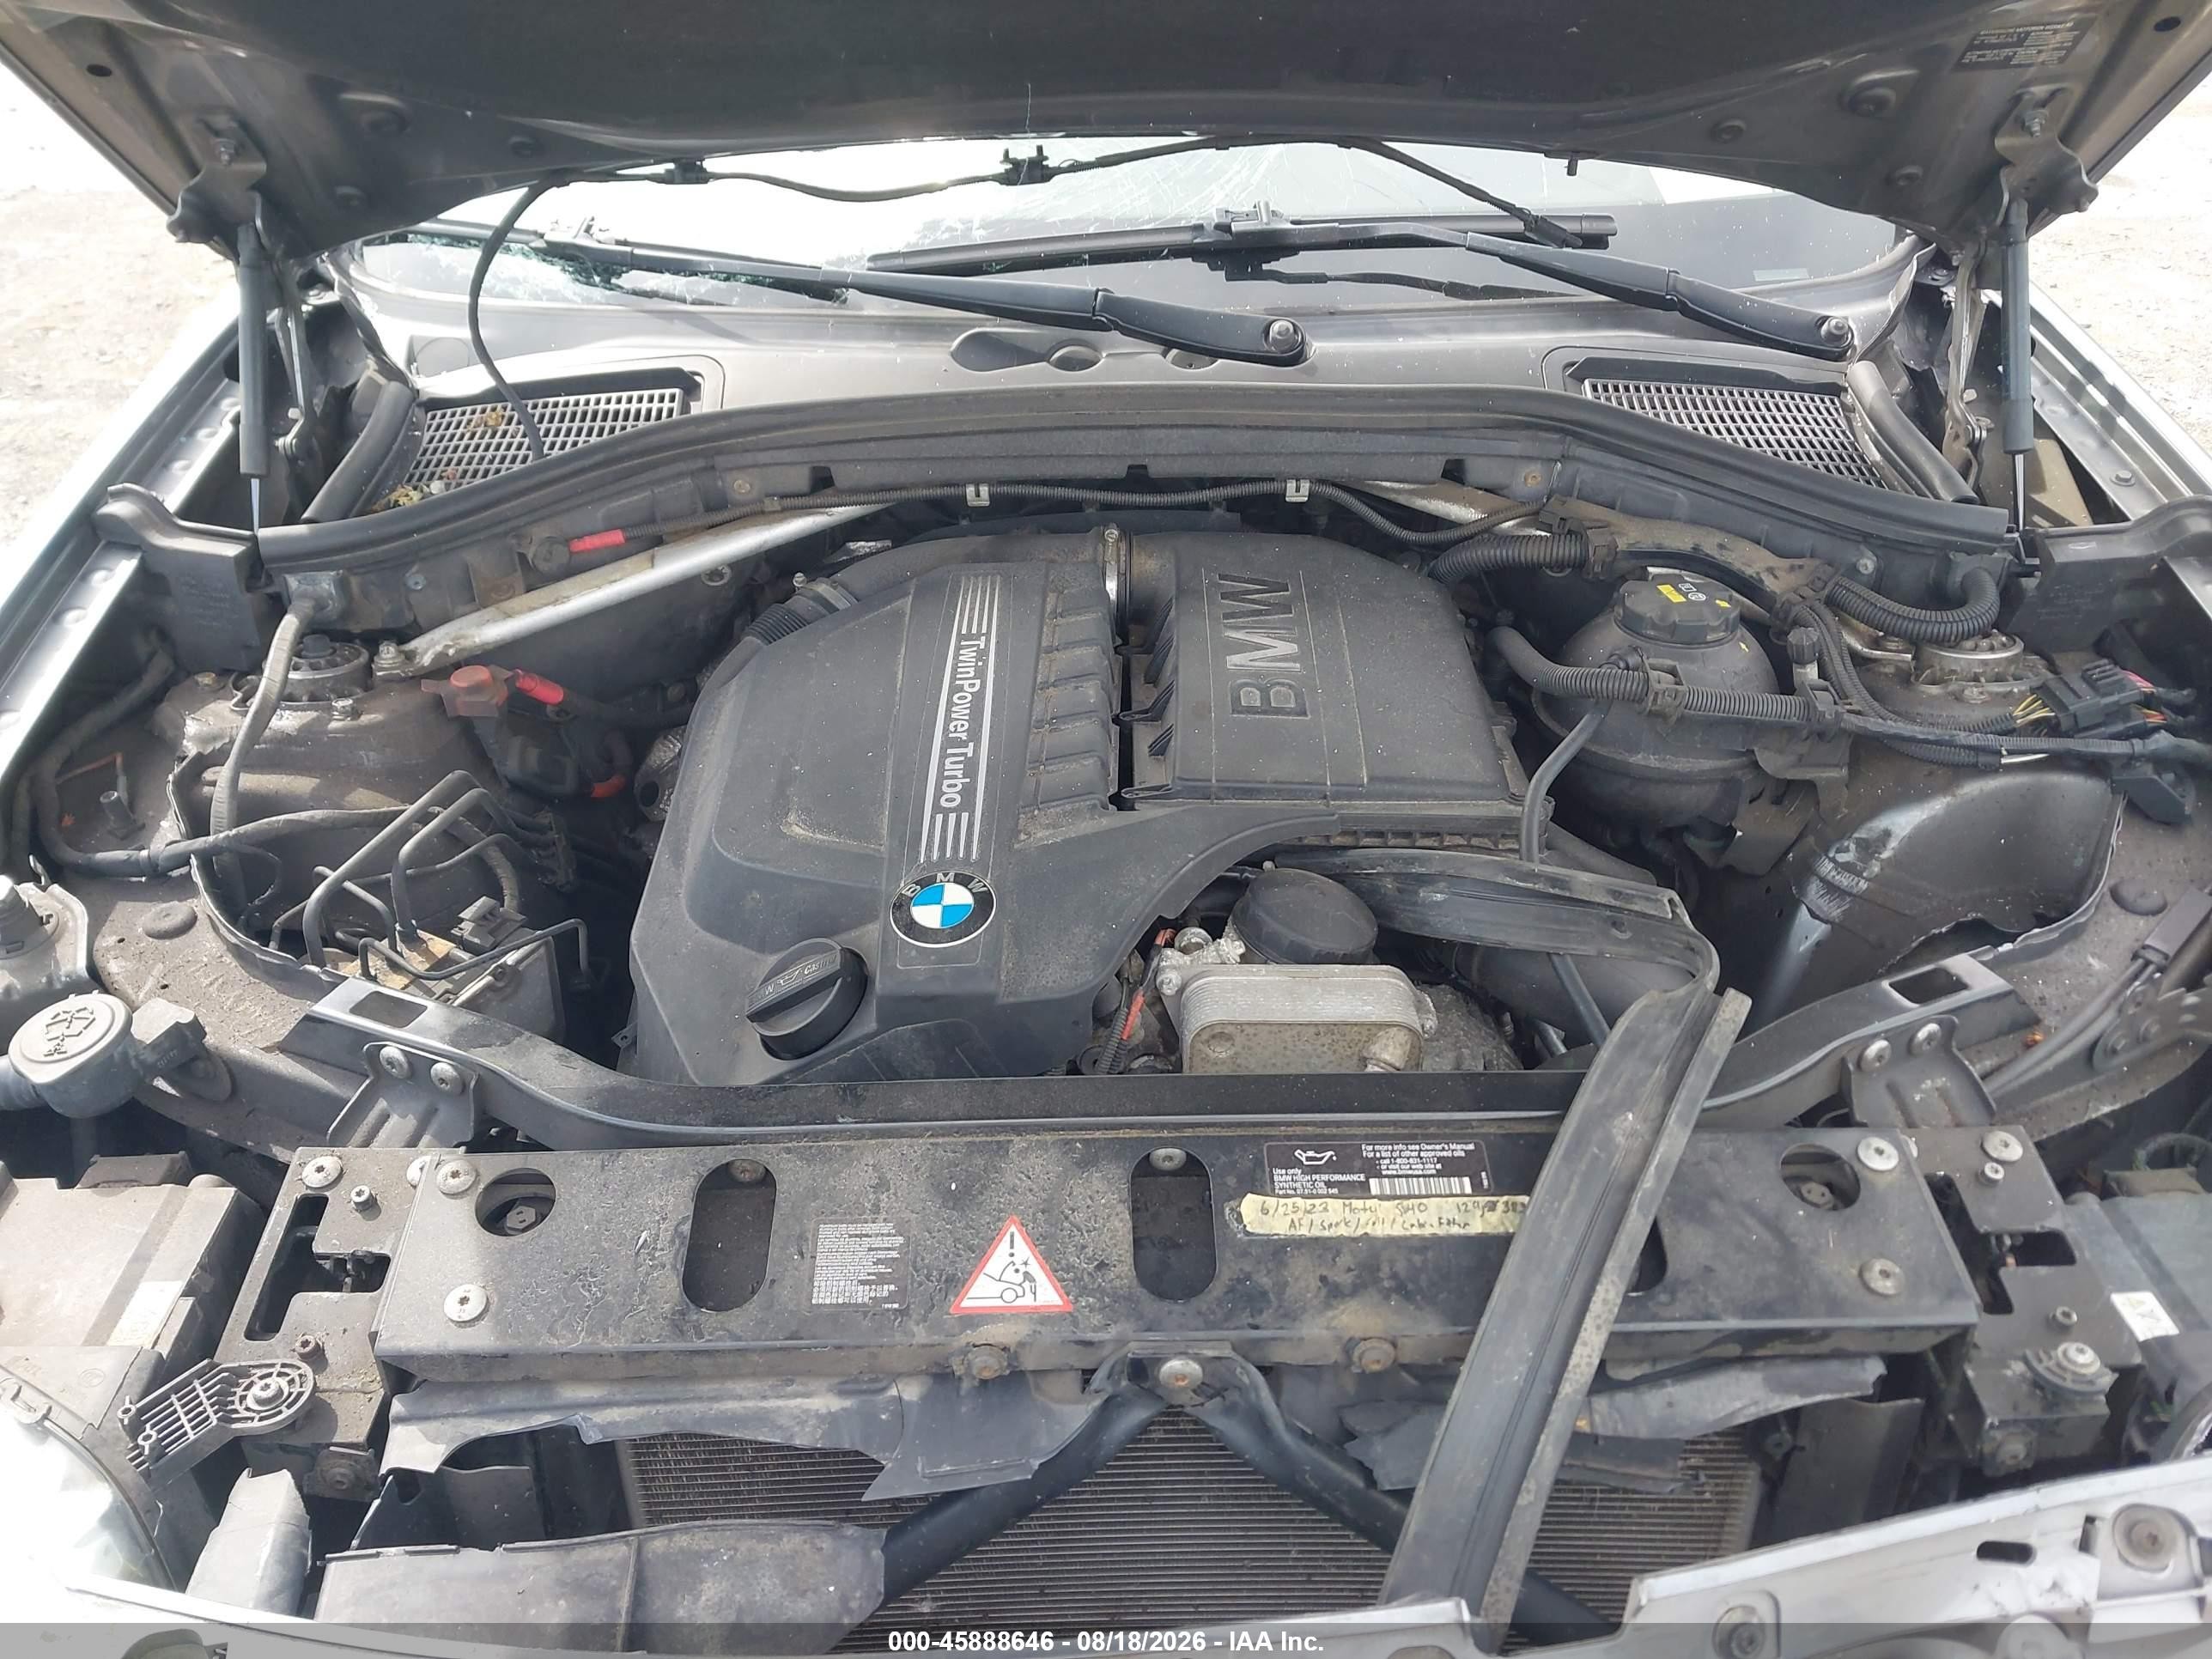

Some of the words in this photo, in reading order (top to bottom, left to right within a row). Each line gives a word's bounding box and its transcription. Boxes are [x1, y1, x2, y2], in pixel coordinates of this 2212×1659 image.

[948, 635, 985, 739] TwinPower
[1218, 573, 1311, 719] BMW
[940, 742, 974, 808] Turbo
[902, 872, 988, 897] BMW
